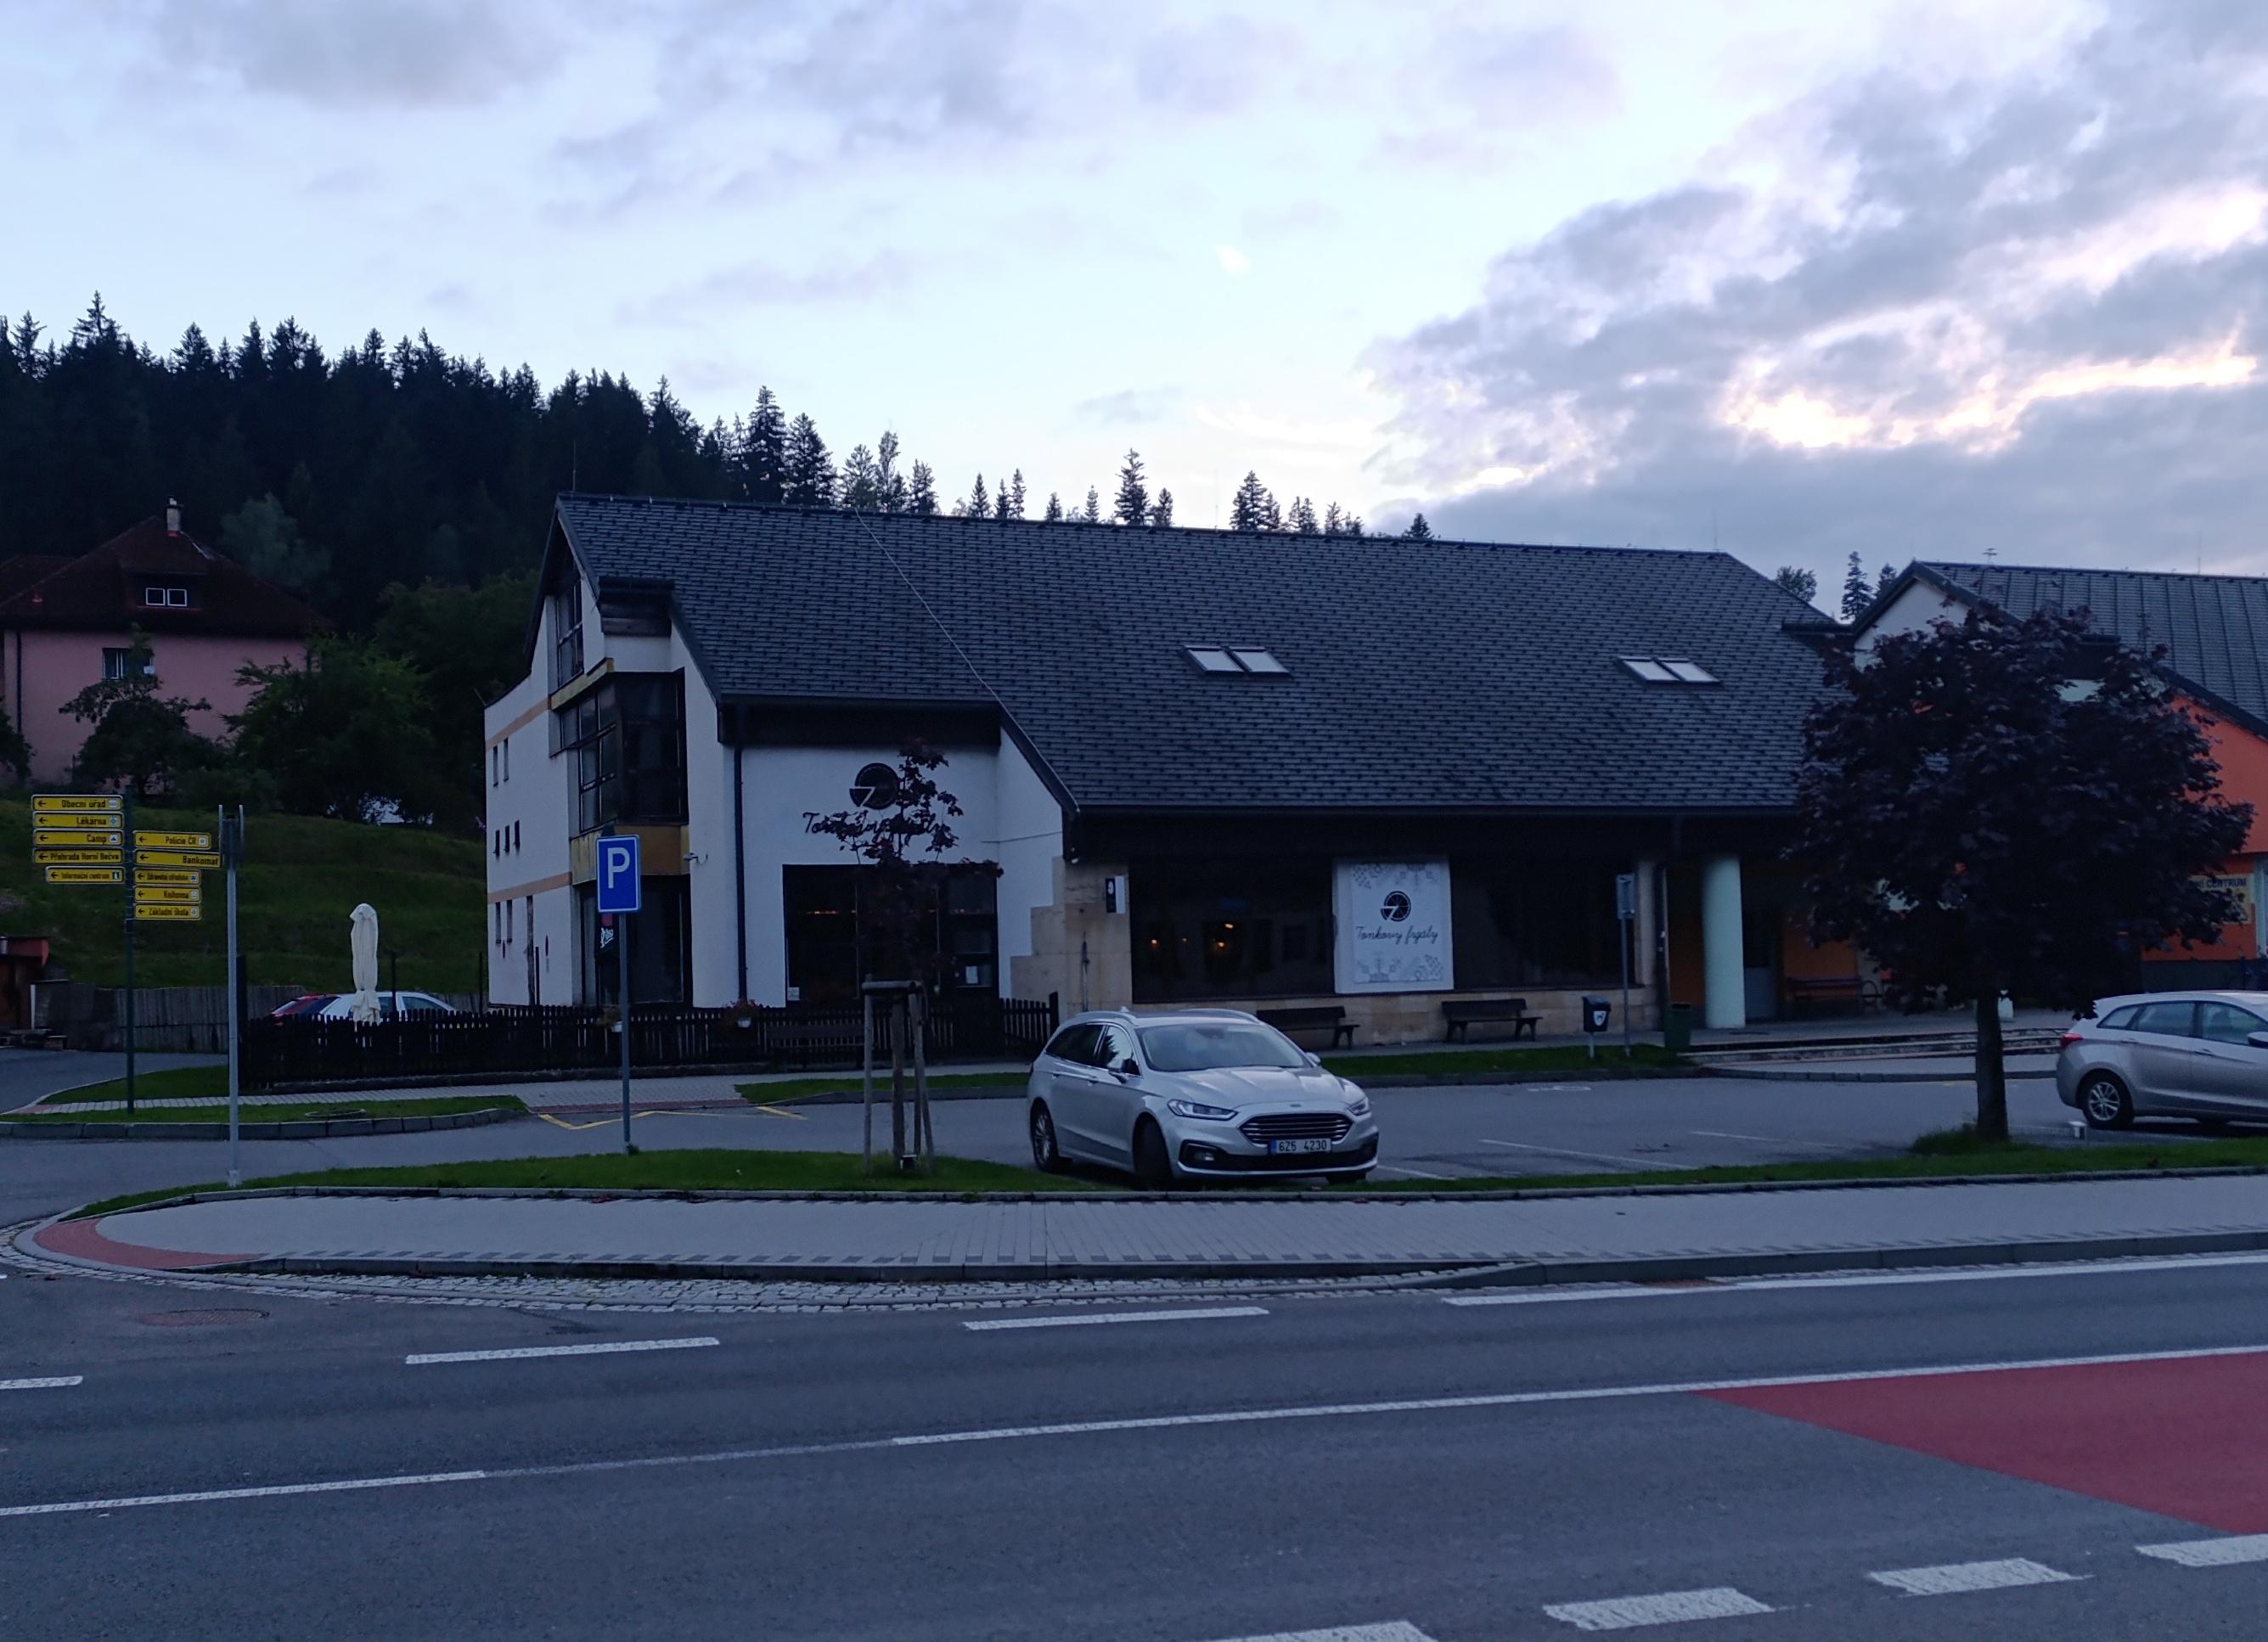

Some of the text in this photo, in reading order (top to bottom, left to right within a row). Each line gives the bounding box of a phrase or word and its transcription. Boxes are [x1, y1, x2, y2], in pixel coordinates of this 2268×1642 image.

[87, 835, 107, 844] Camp
[165, 836, 186, 845] Policie
[183, 856, 218, 864] Bankomat
[607, 846, 631, 889] P
[1303, 1139, 1327, 1150] 4230
